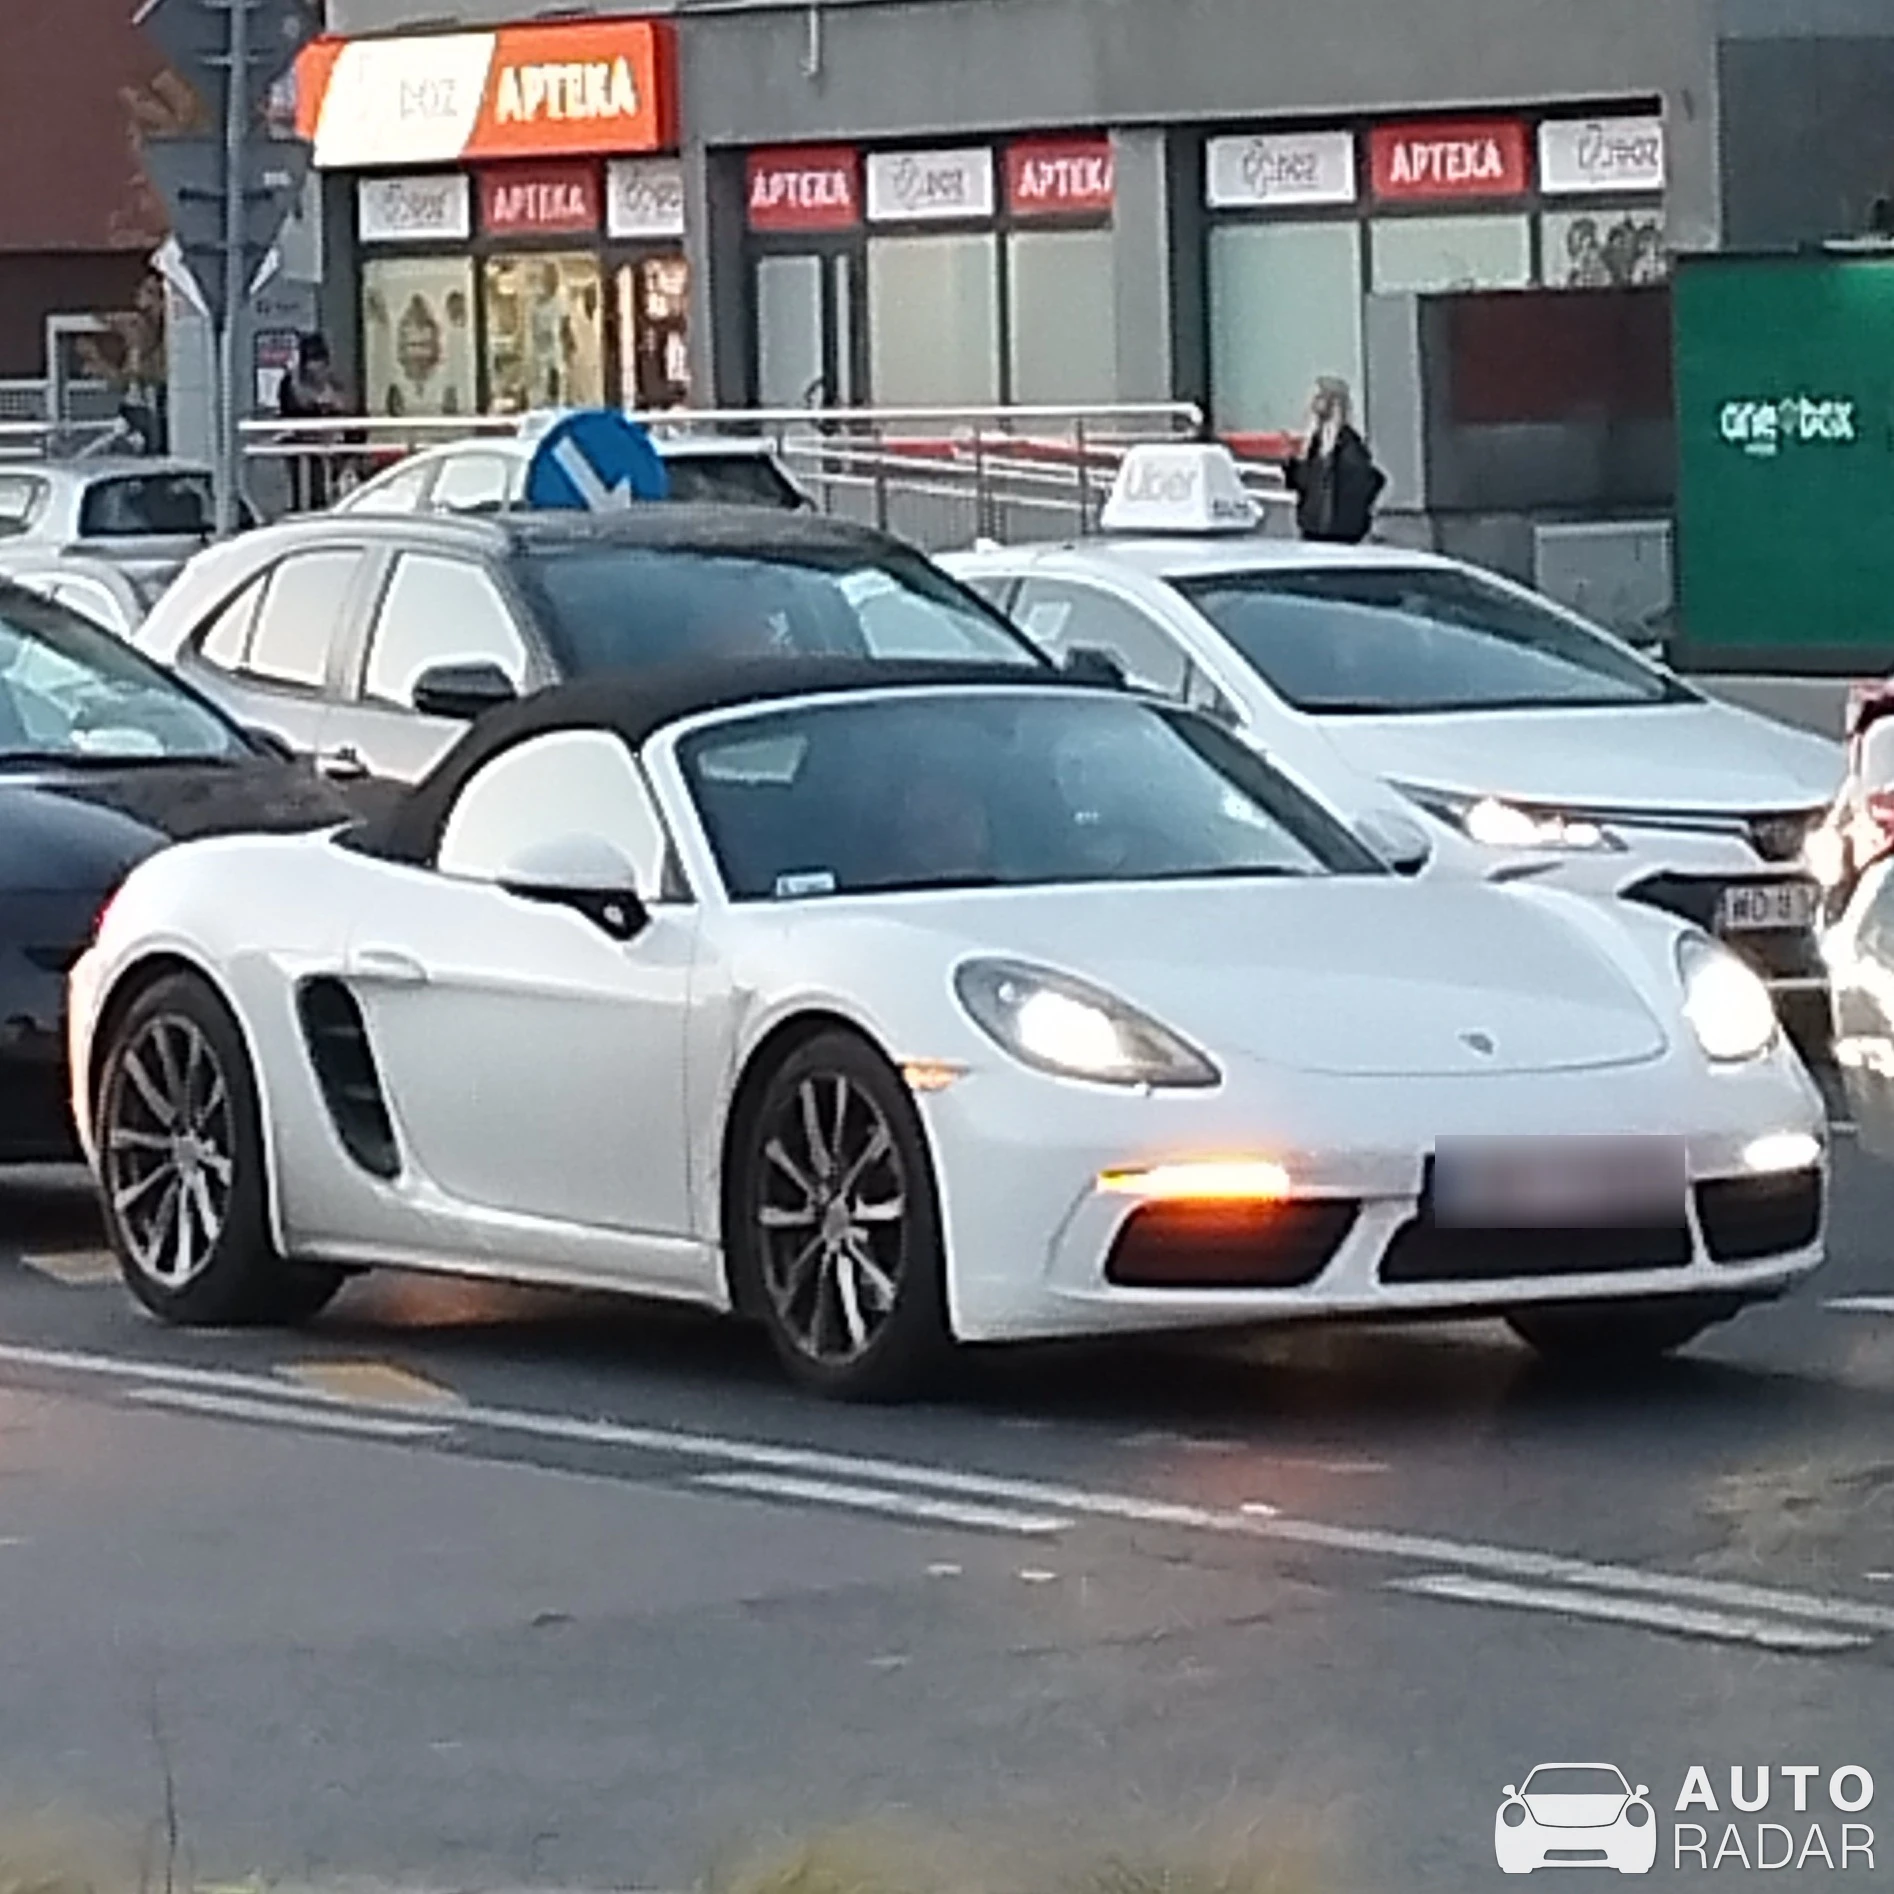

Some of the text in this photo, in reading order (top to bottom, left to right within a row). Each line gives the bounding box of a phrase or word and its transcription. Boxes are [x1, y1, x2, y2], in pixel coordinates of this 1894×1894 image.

[495, 56, 639, 125] APTEKA
[1390, 138, 1504, 184] APTEKA
[493, 182, 588, 223] APTEKA
[750, 168, 852, 209] APTEKA
[1800, 394, 1855, 440] box
[1124, 457, 1197, 501] Uber
